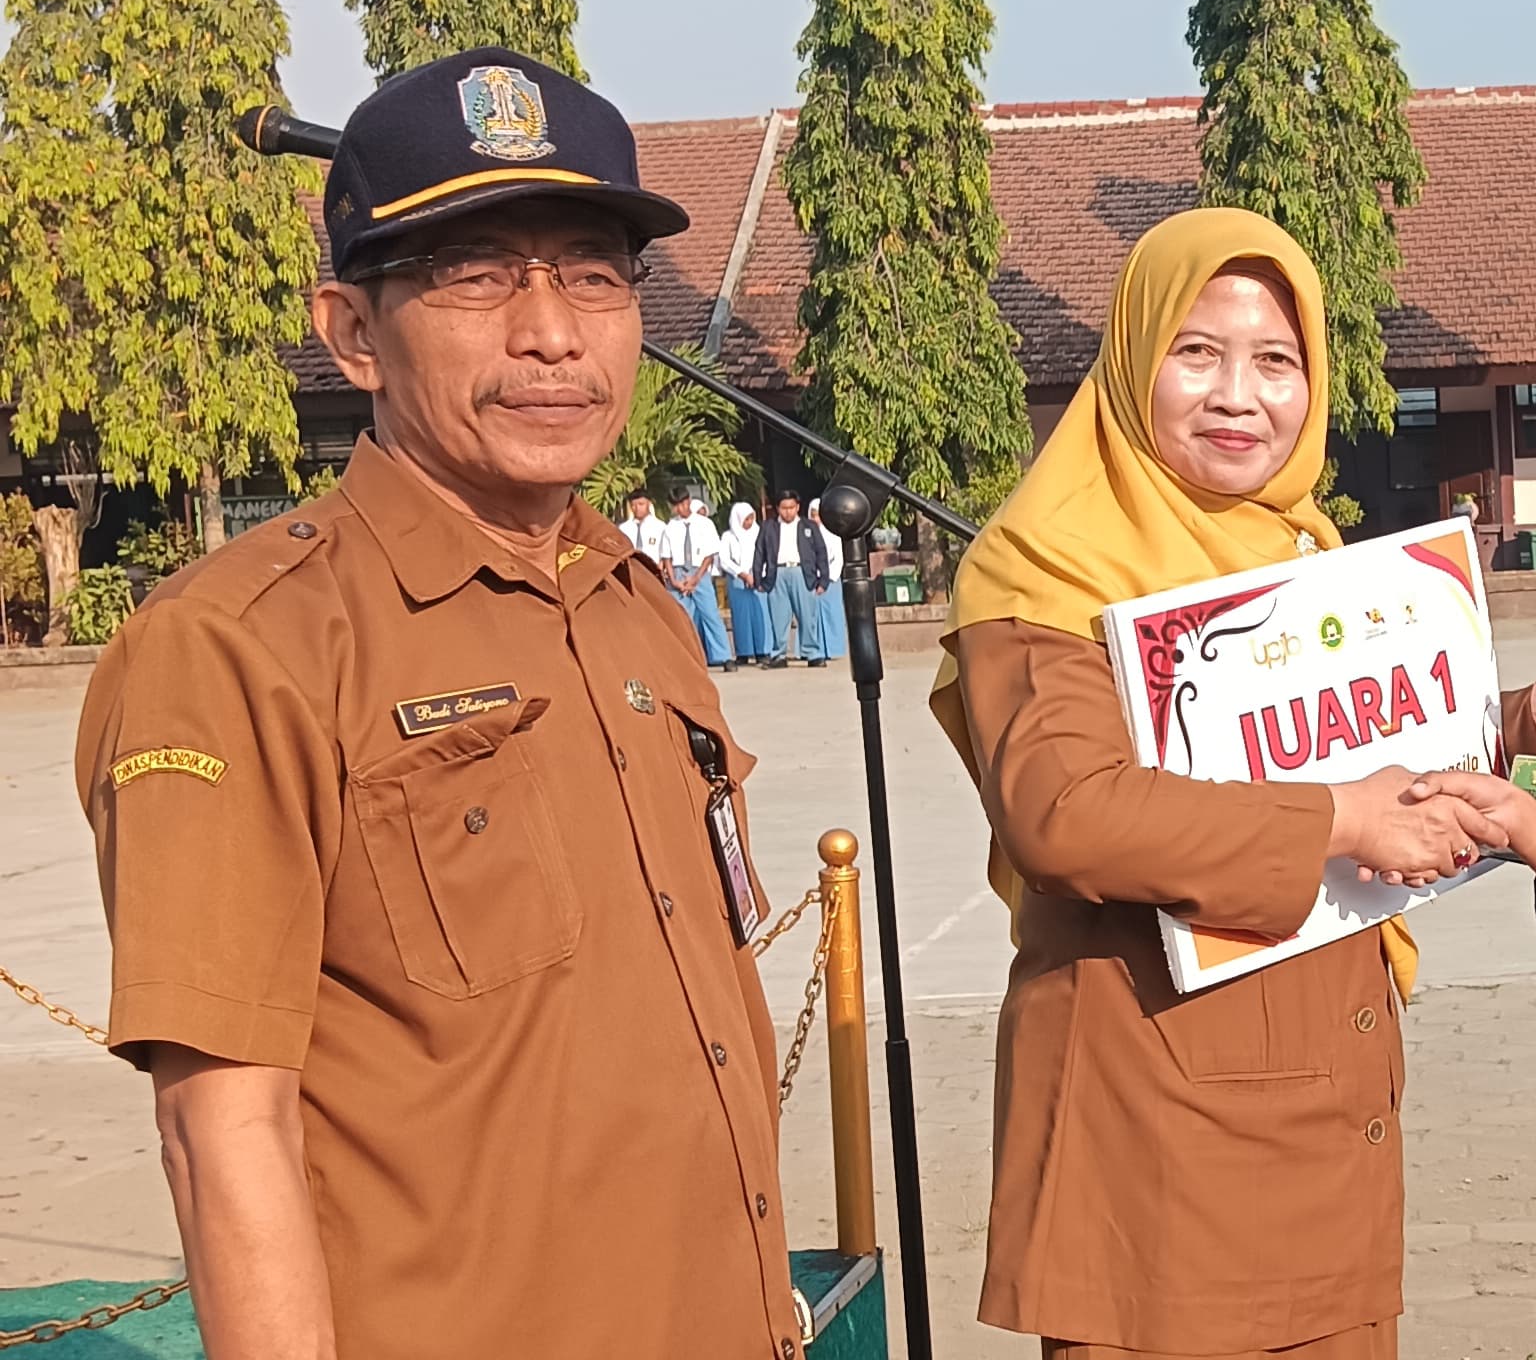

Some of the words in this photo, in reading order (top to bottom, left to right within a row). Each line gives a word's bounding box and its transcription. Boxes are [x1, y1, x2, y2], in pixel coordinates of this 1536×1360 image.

[1239, 664, 1428, 781] JUARA
[1430, 650, 1457, 714] 1
[116, 753, 149, 780] DINAS
[149, 750, 222, 778] PENDIDIKAN
